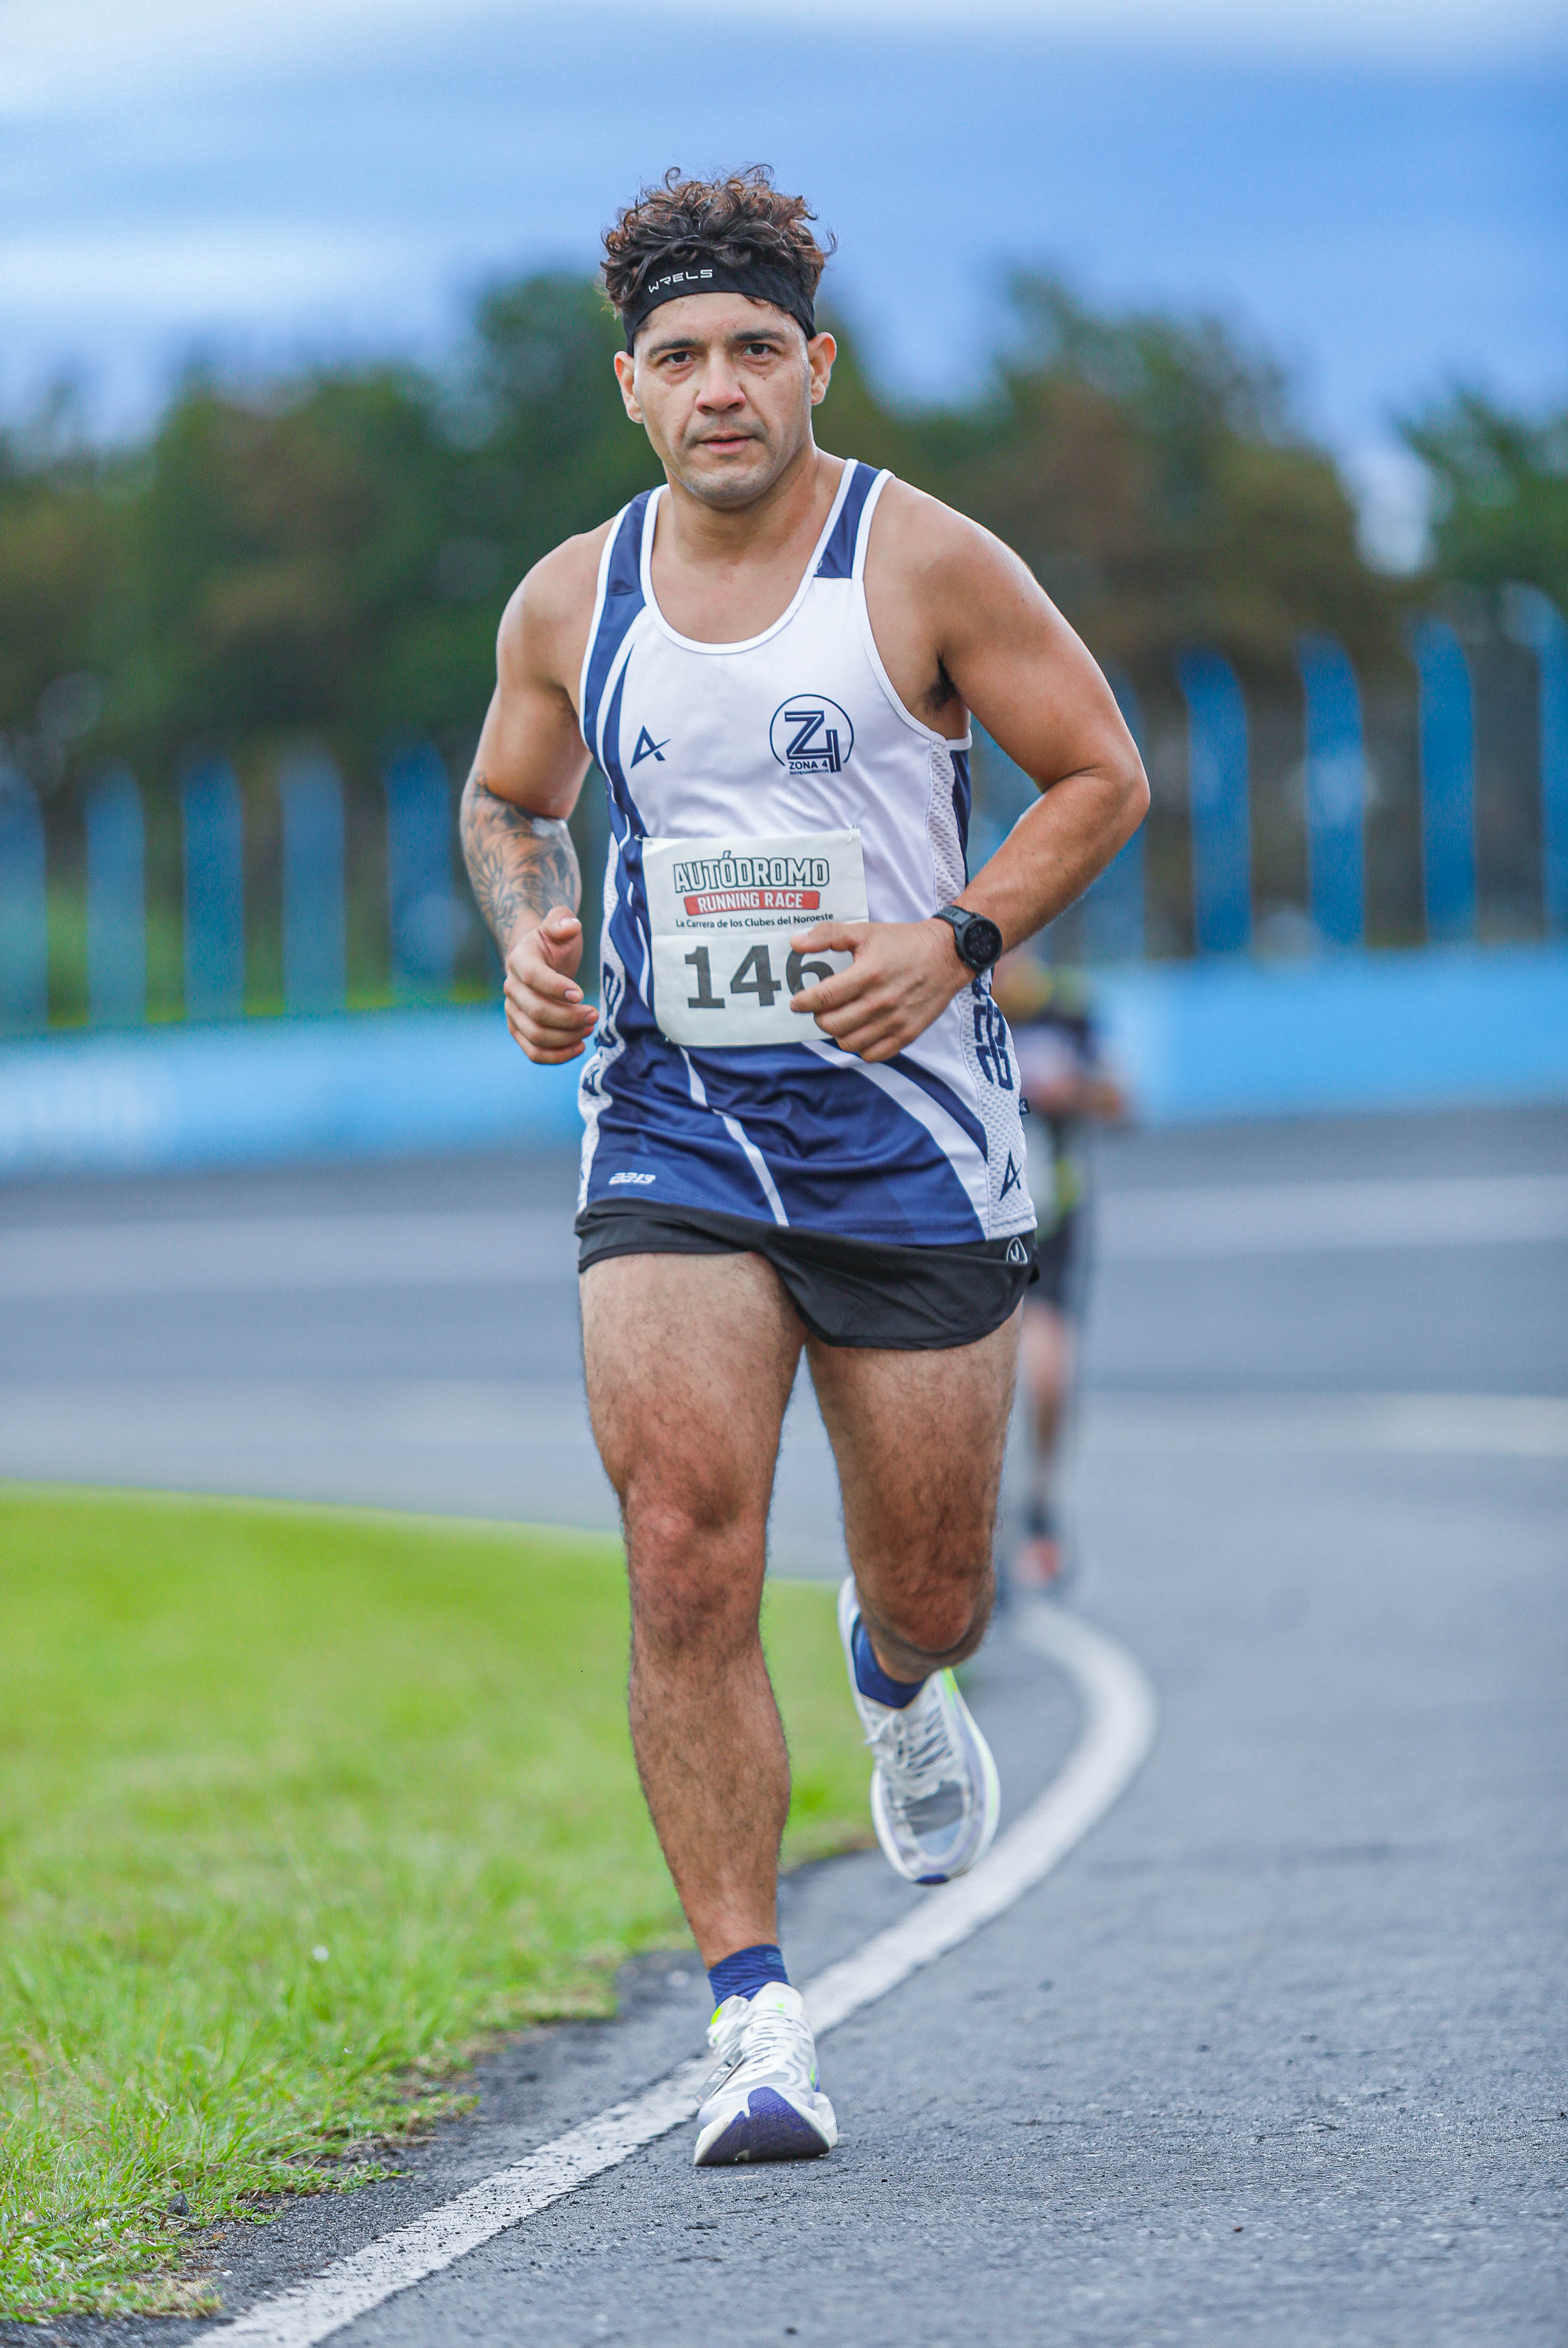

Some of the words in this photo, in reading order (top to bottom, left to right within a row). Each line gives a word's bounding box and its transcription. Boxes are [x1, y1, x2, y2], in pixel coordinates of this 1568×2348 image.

[789, 760, 818, 769] ZONA
[673, 850, 830, 893] AUTÓDROMO
[697, 891, 760, 913] RUNNING
[764, 892, 803, 908] RACE
[676, 919, 685, 928] La
[686, 919, 715, 928] Carrera
[717, 918, 728, 928] de
[730, 917, 743, 928] los
[745, 917, 774, 927] Clubes
[777, 915, 791, 925] del
[794, 912, 834, 924] Noroeste
